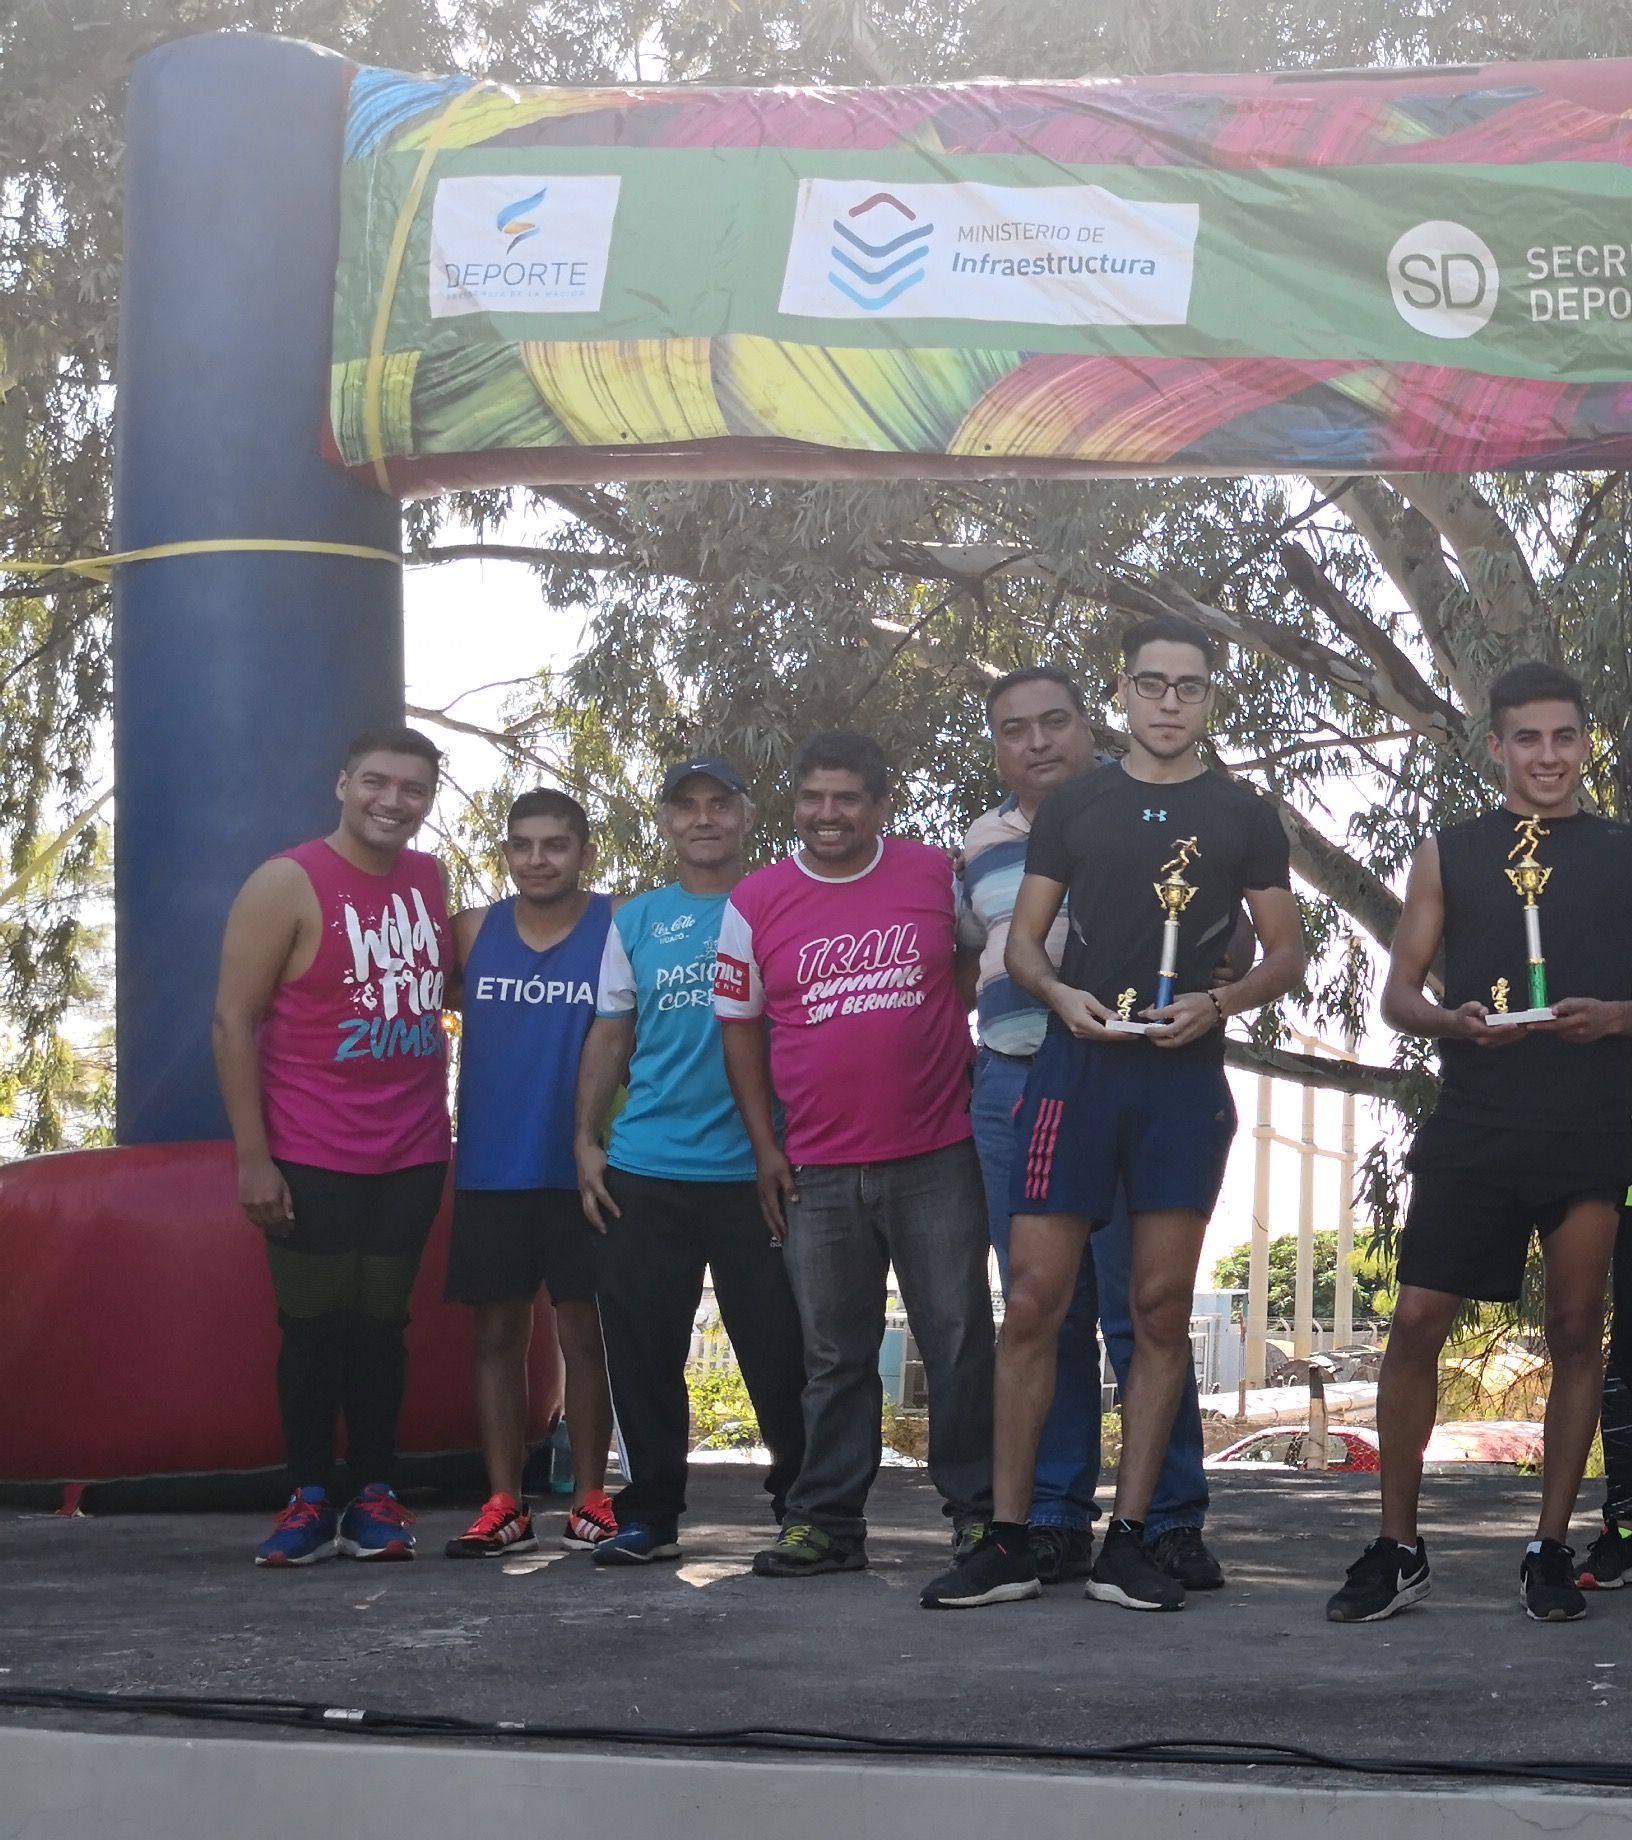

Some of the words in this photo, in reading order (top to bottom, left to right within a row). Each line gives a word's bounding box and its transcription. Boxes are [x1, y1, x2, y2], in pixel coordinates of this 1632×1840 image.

[957, 222, 1071, 242] MINISTERIO
[1077, 227, 1105, 243] DE
[445, 262, 589, 288] DEPORTE
[952, 251, 1156, 276] Infraestructura
[1398, 253, 1487, 309] SD
[797, 923, 920, 985] TRAIL
[476, 974, 595, 1005] ETIÓPIA
[656, 961, 717, 990] PASIO
[802, 965, 925, 1005] RUNNING
[806, 1000, 838, 1025] SAN
[841, 990, 926, 1015] BERNARDO
[335, 1012, 443, 1063] ZUMB
